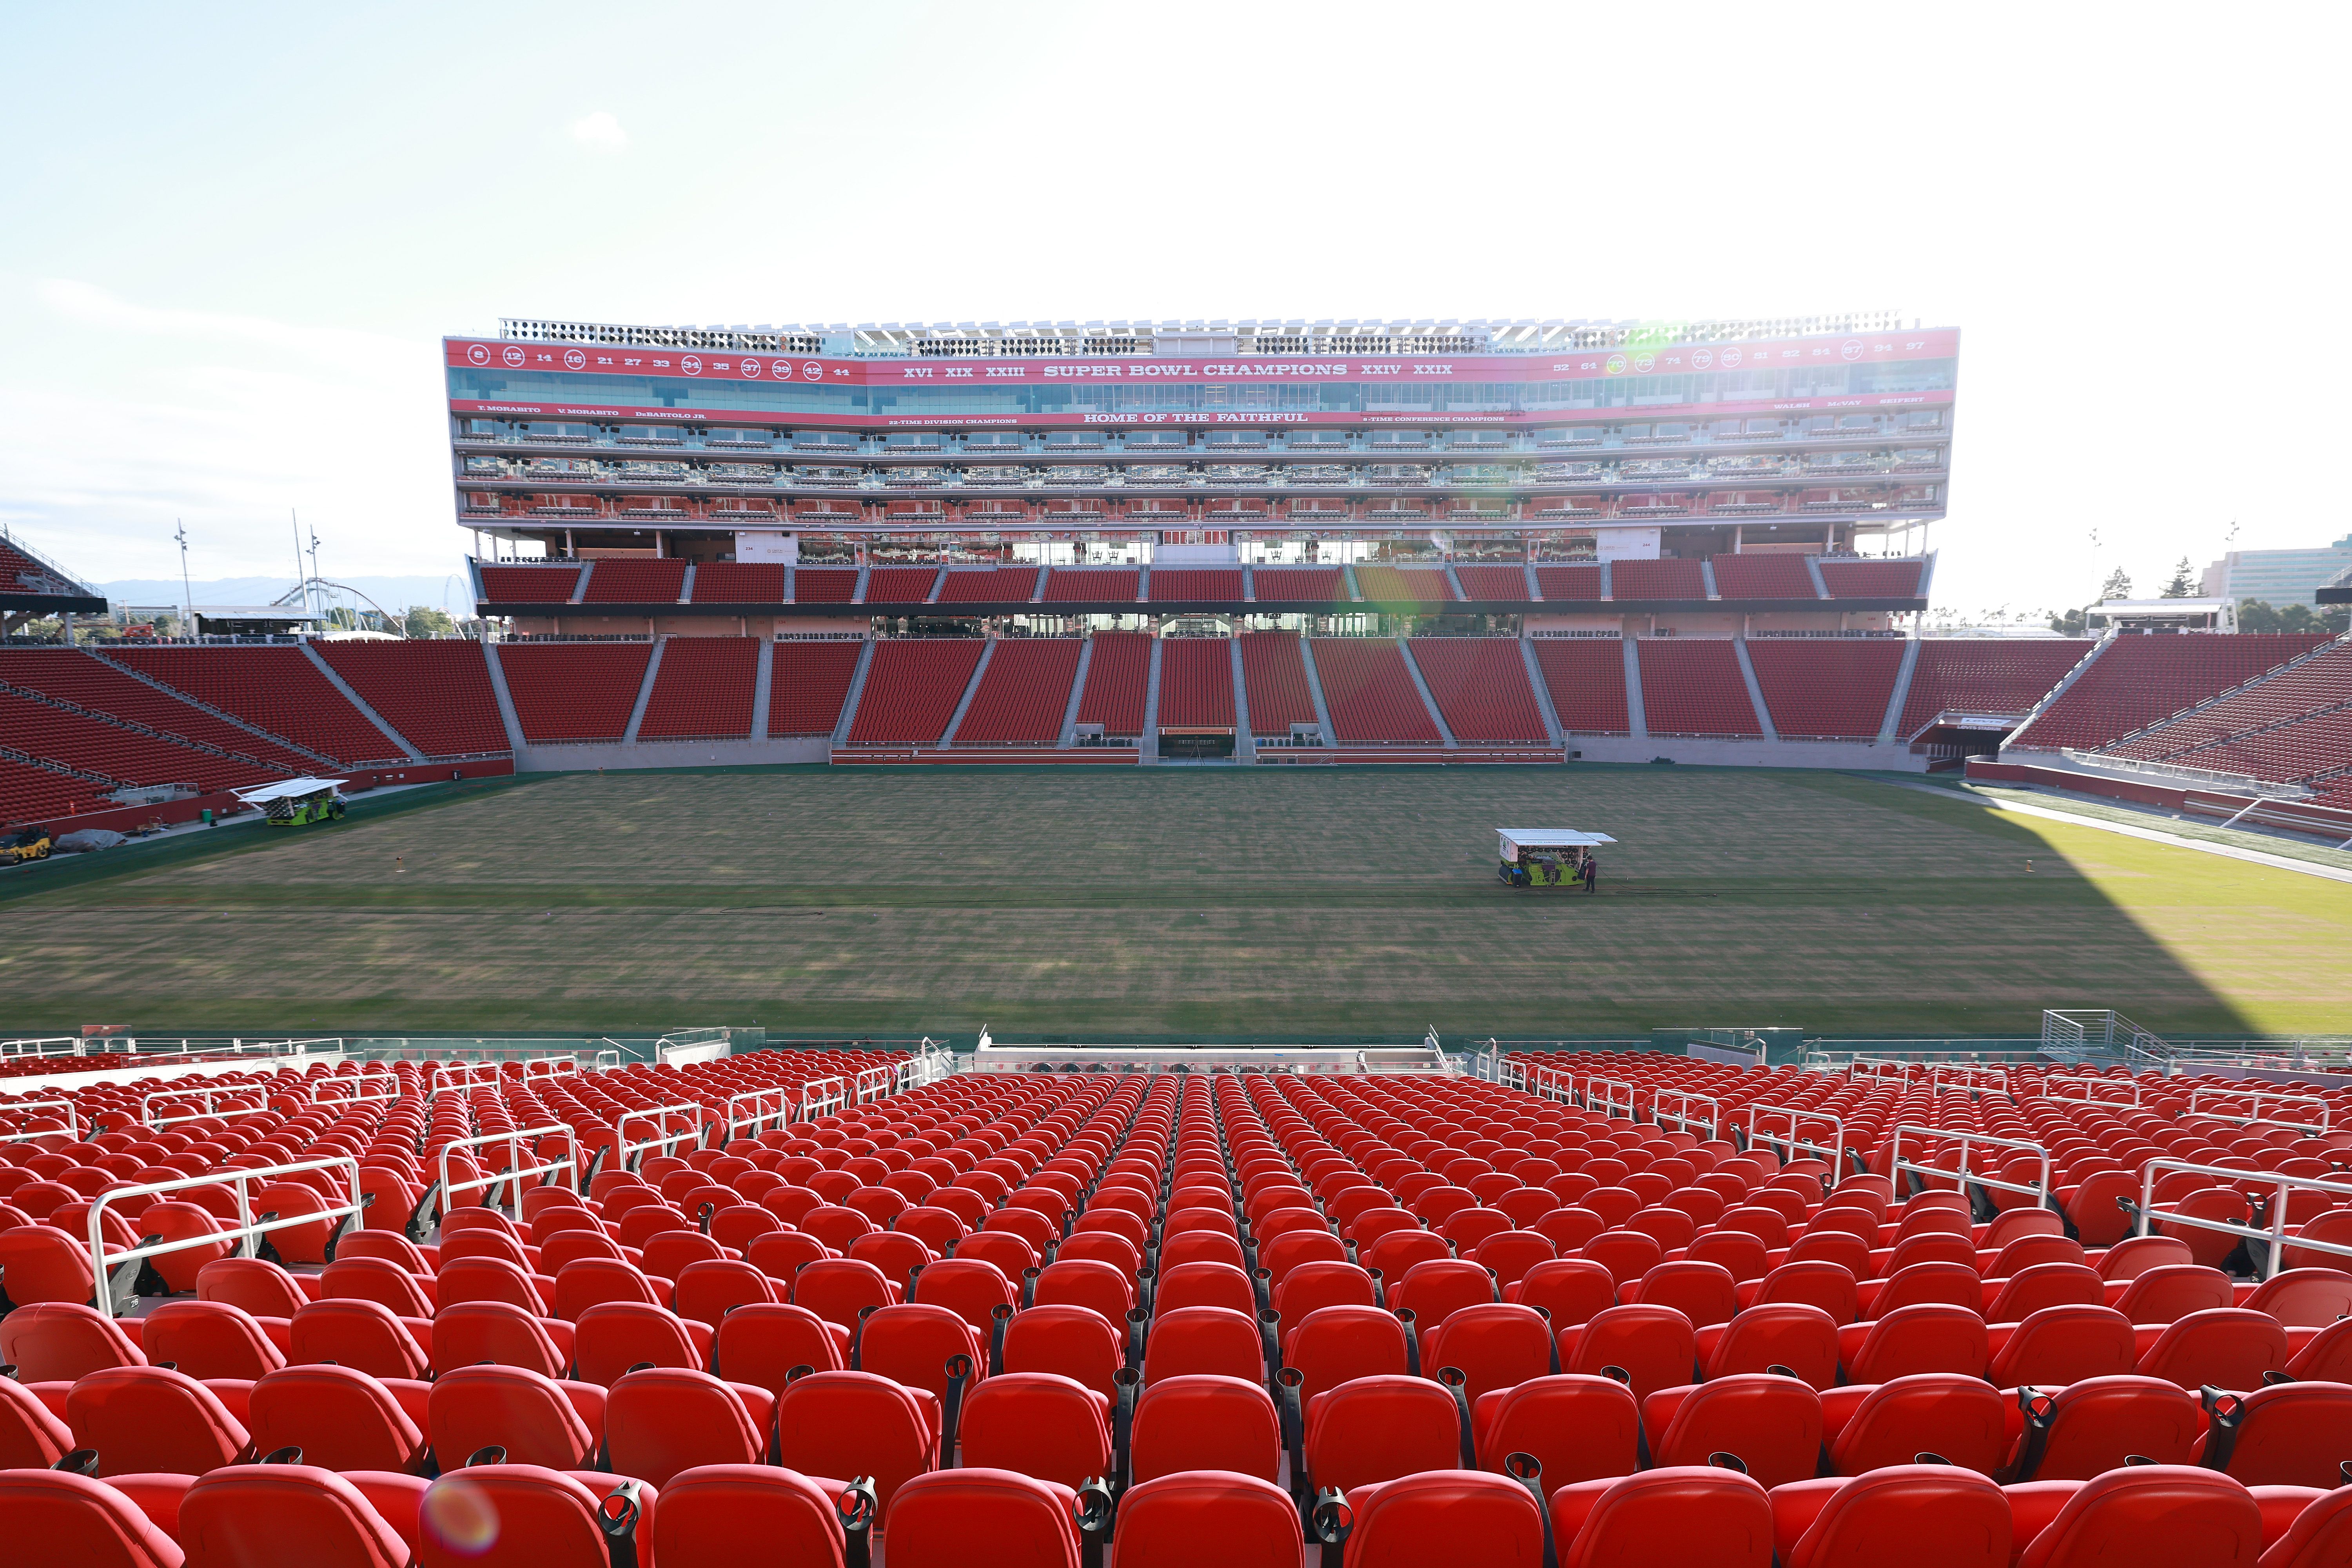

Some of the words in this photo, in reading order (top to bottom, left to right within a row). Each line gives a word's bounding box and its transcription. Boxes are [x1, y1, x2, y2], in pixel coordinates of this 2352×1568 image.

[904, 368, 933, 377] XVI
[946, 368, 973, 377] XIX
[986, 367, 1025, 376] XXIII
[1044, 366, 1121, 376] SUPER
[1129, 365, 1197, 376] BOWL
[1203, 365, 1347, 375] CHAMPIONS
[1361, 365, 1401, 374] XXIV
[1414, 365, 1452, 374] XXIX
[131, 1298, 138, 1308] 26
